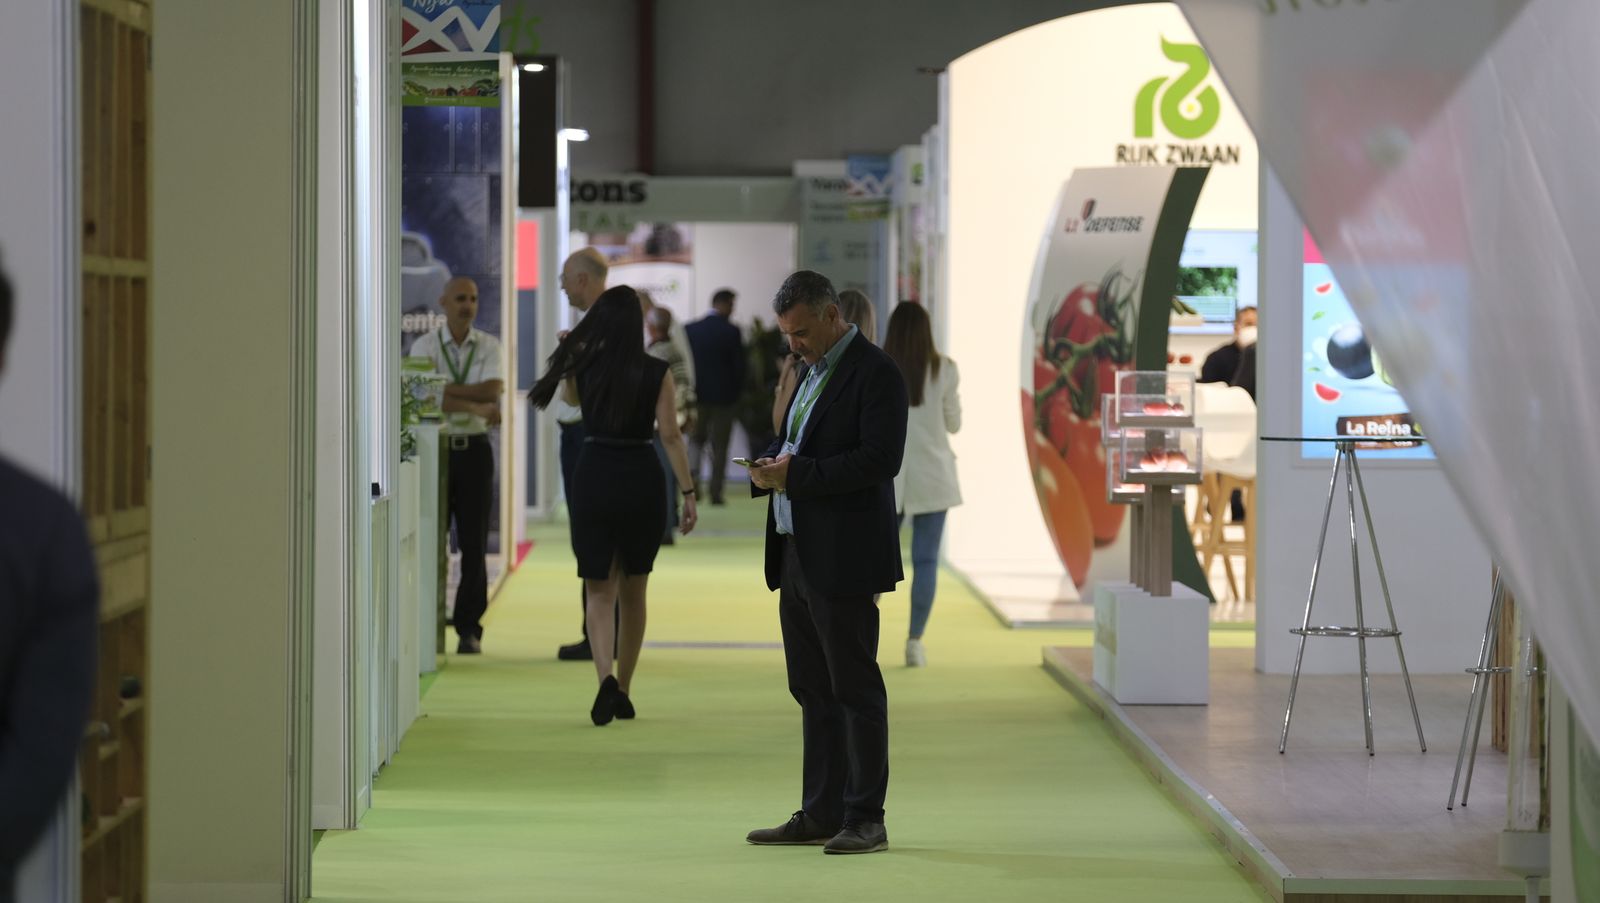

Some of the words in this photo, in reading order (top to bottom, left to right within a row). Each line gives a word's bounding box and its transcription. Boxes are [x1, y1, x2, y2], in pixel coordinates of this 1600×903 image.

[1166, 144, 1241, 165] ZWAAN
[571, 178, 648, 204] ons
[1345, 420, 1365, 436] La
[1366, 419, 1411, 436] Reina
